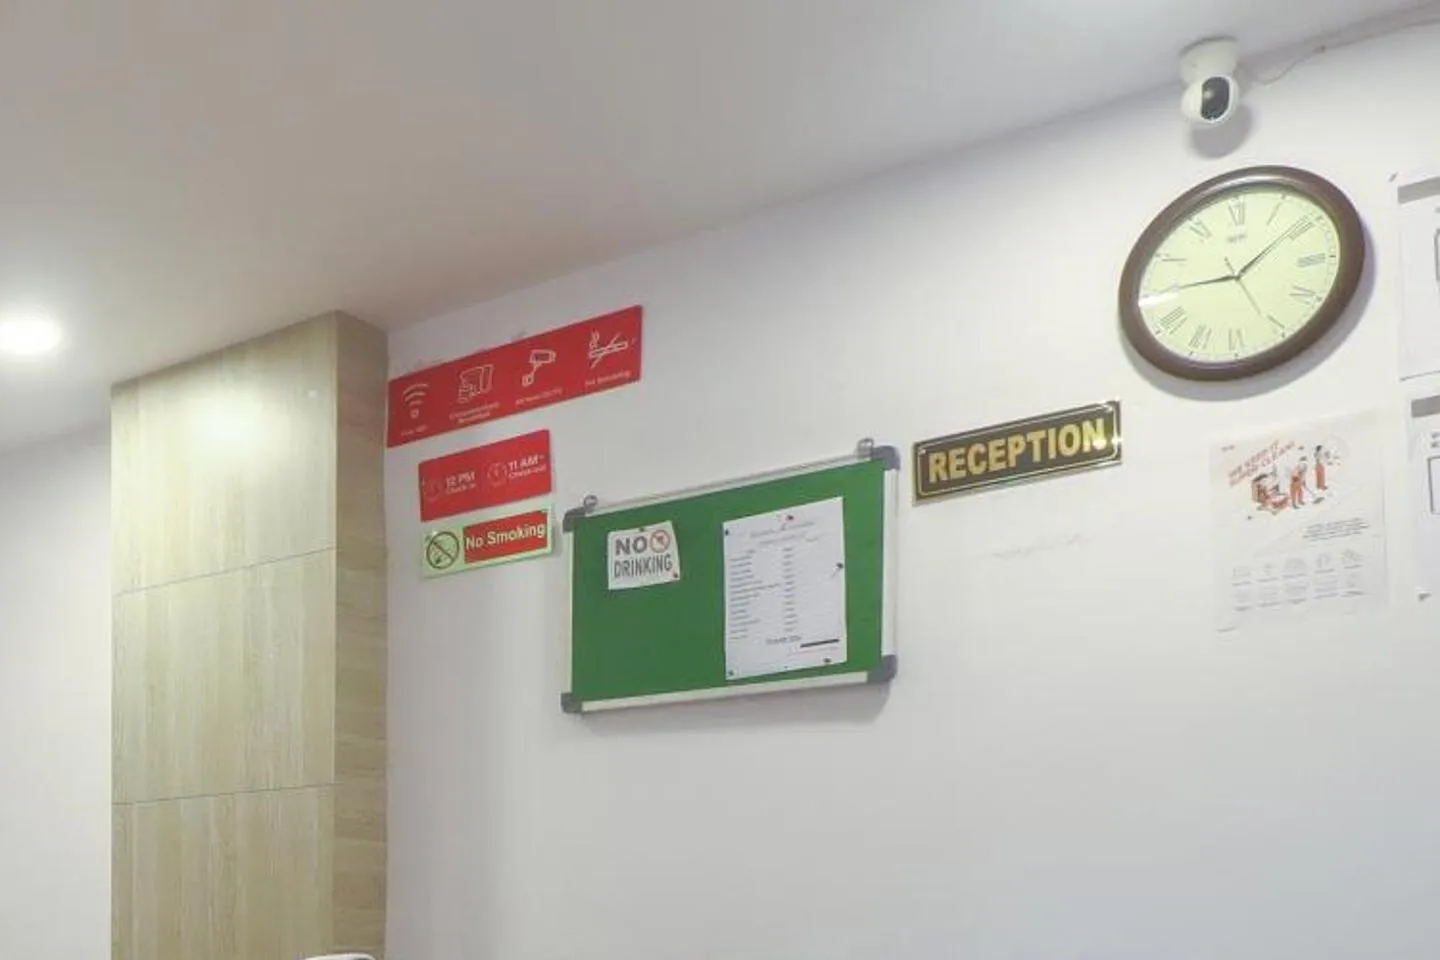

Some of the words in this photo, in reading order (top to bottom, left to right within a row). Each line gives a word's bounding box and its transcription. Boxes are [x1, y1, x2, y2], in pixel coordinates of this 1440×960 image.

[928, 417, 1108, 484] RECEPTION
[465, 536, 484, 551] No
[487, 523, 546, 546] Smoking
[615, 535, 648, 556] NO
[614, 553, 673, 578] DRINKING
